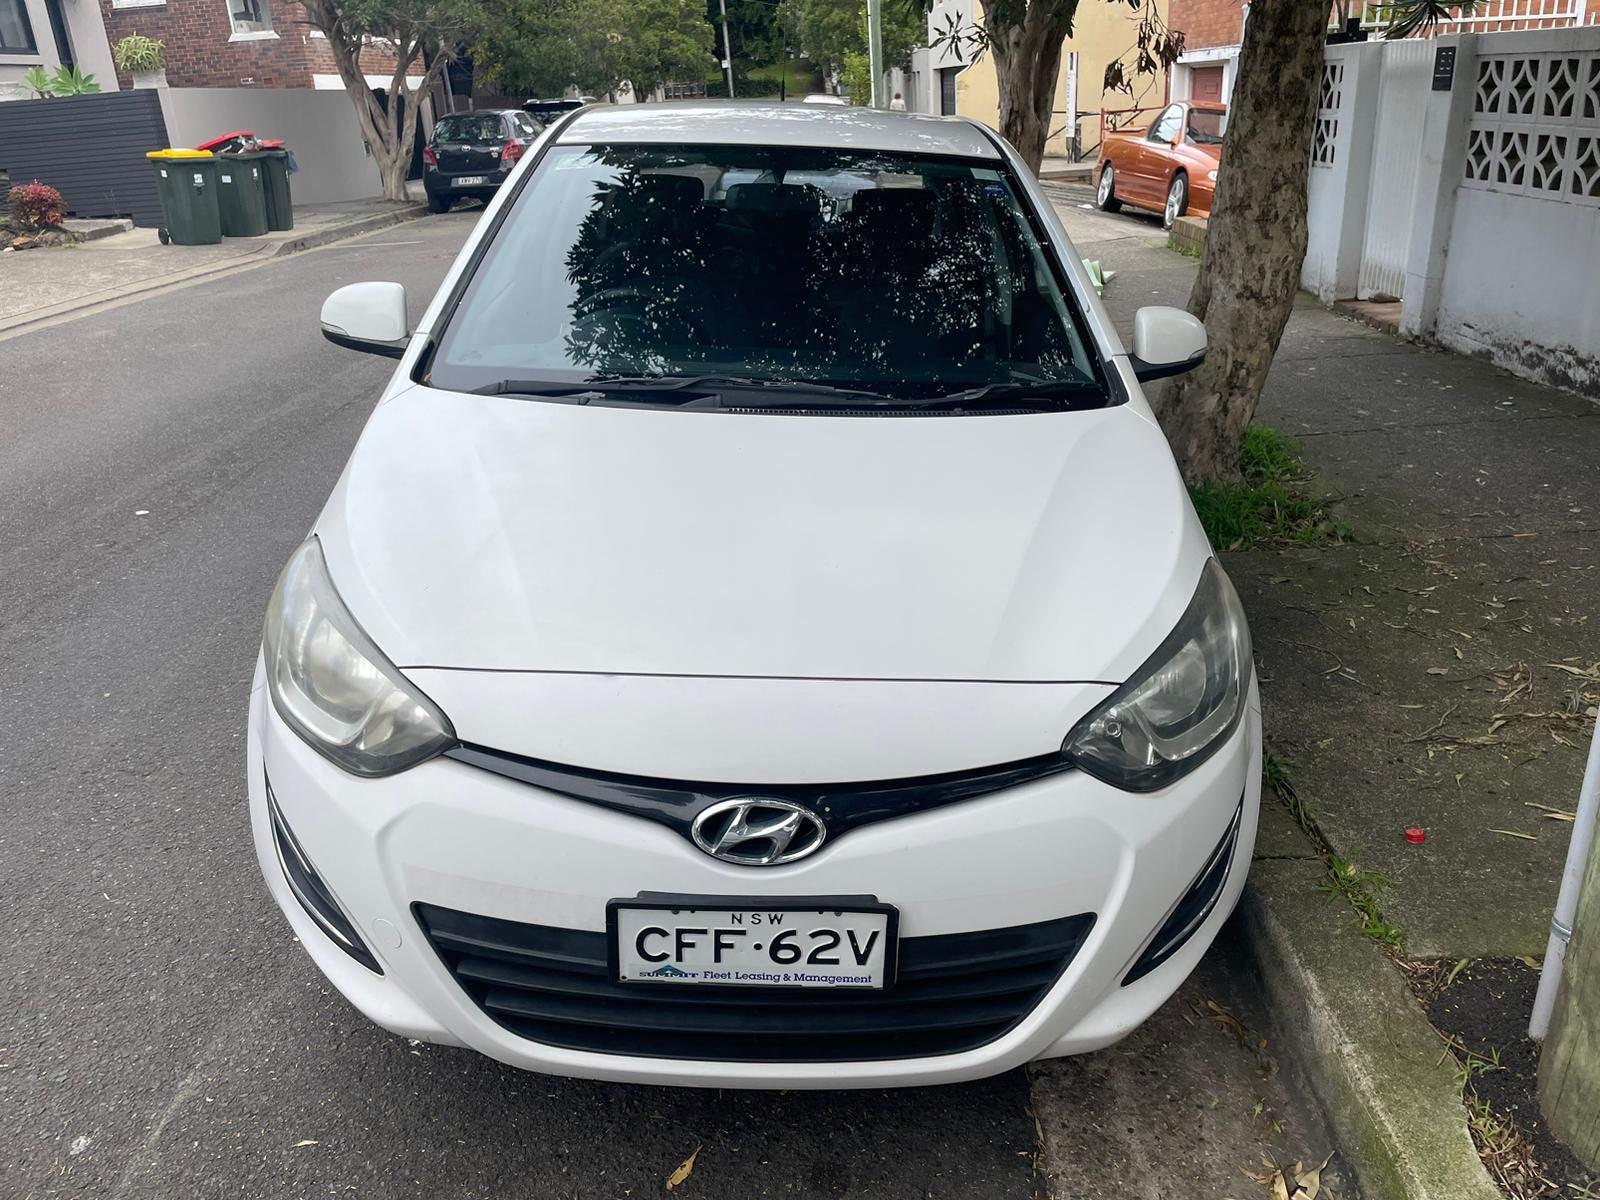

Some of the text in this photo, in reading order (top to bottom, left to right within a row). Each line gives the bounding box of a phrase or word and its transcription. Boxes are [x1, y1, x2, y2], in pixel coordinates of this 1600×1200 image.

[731, 913, 784, 925] NSW
[703, 971, 731, 980] Fleet
[735, 972, 780, 983] Leasing
[794, 973, 872, 984] Management
